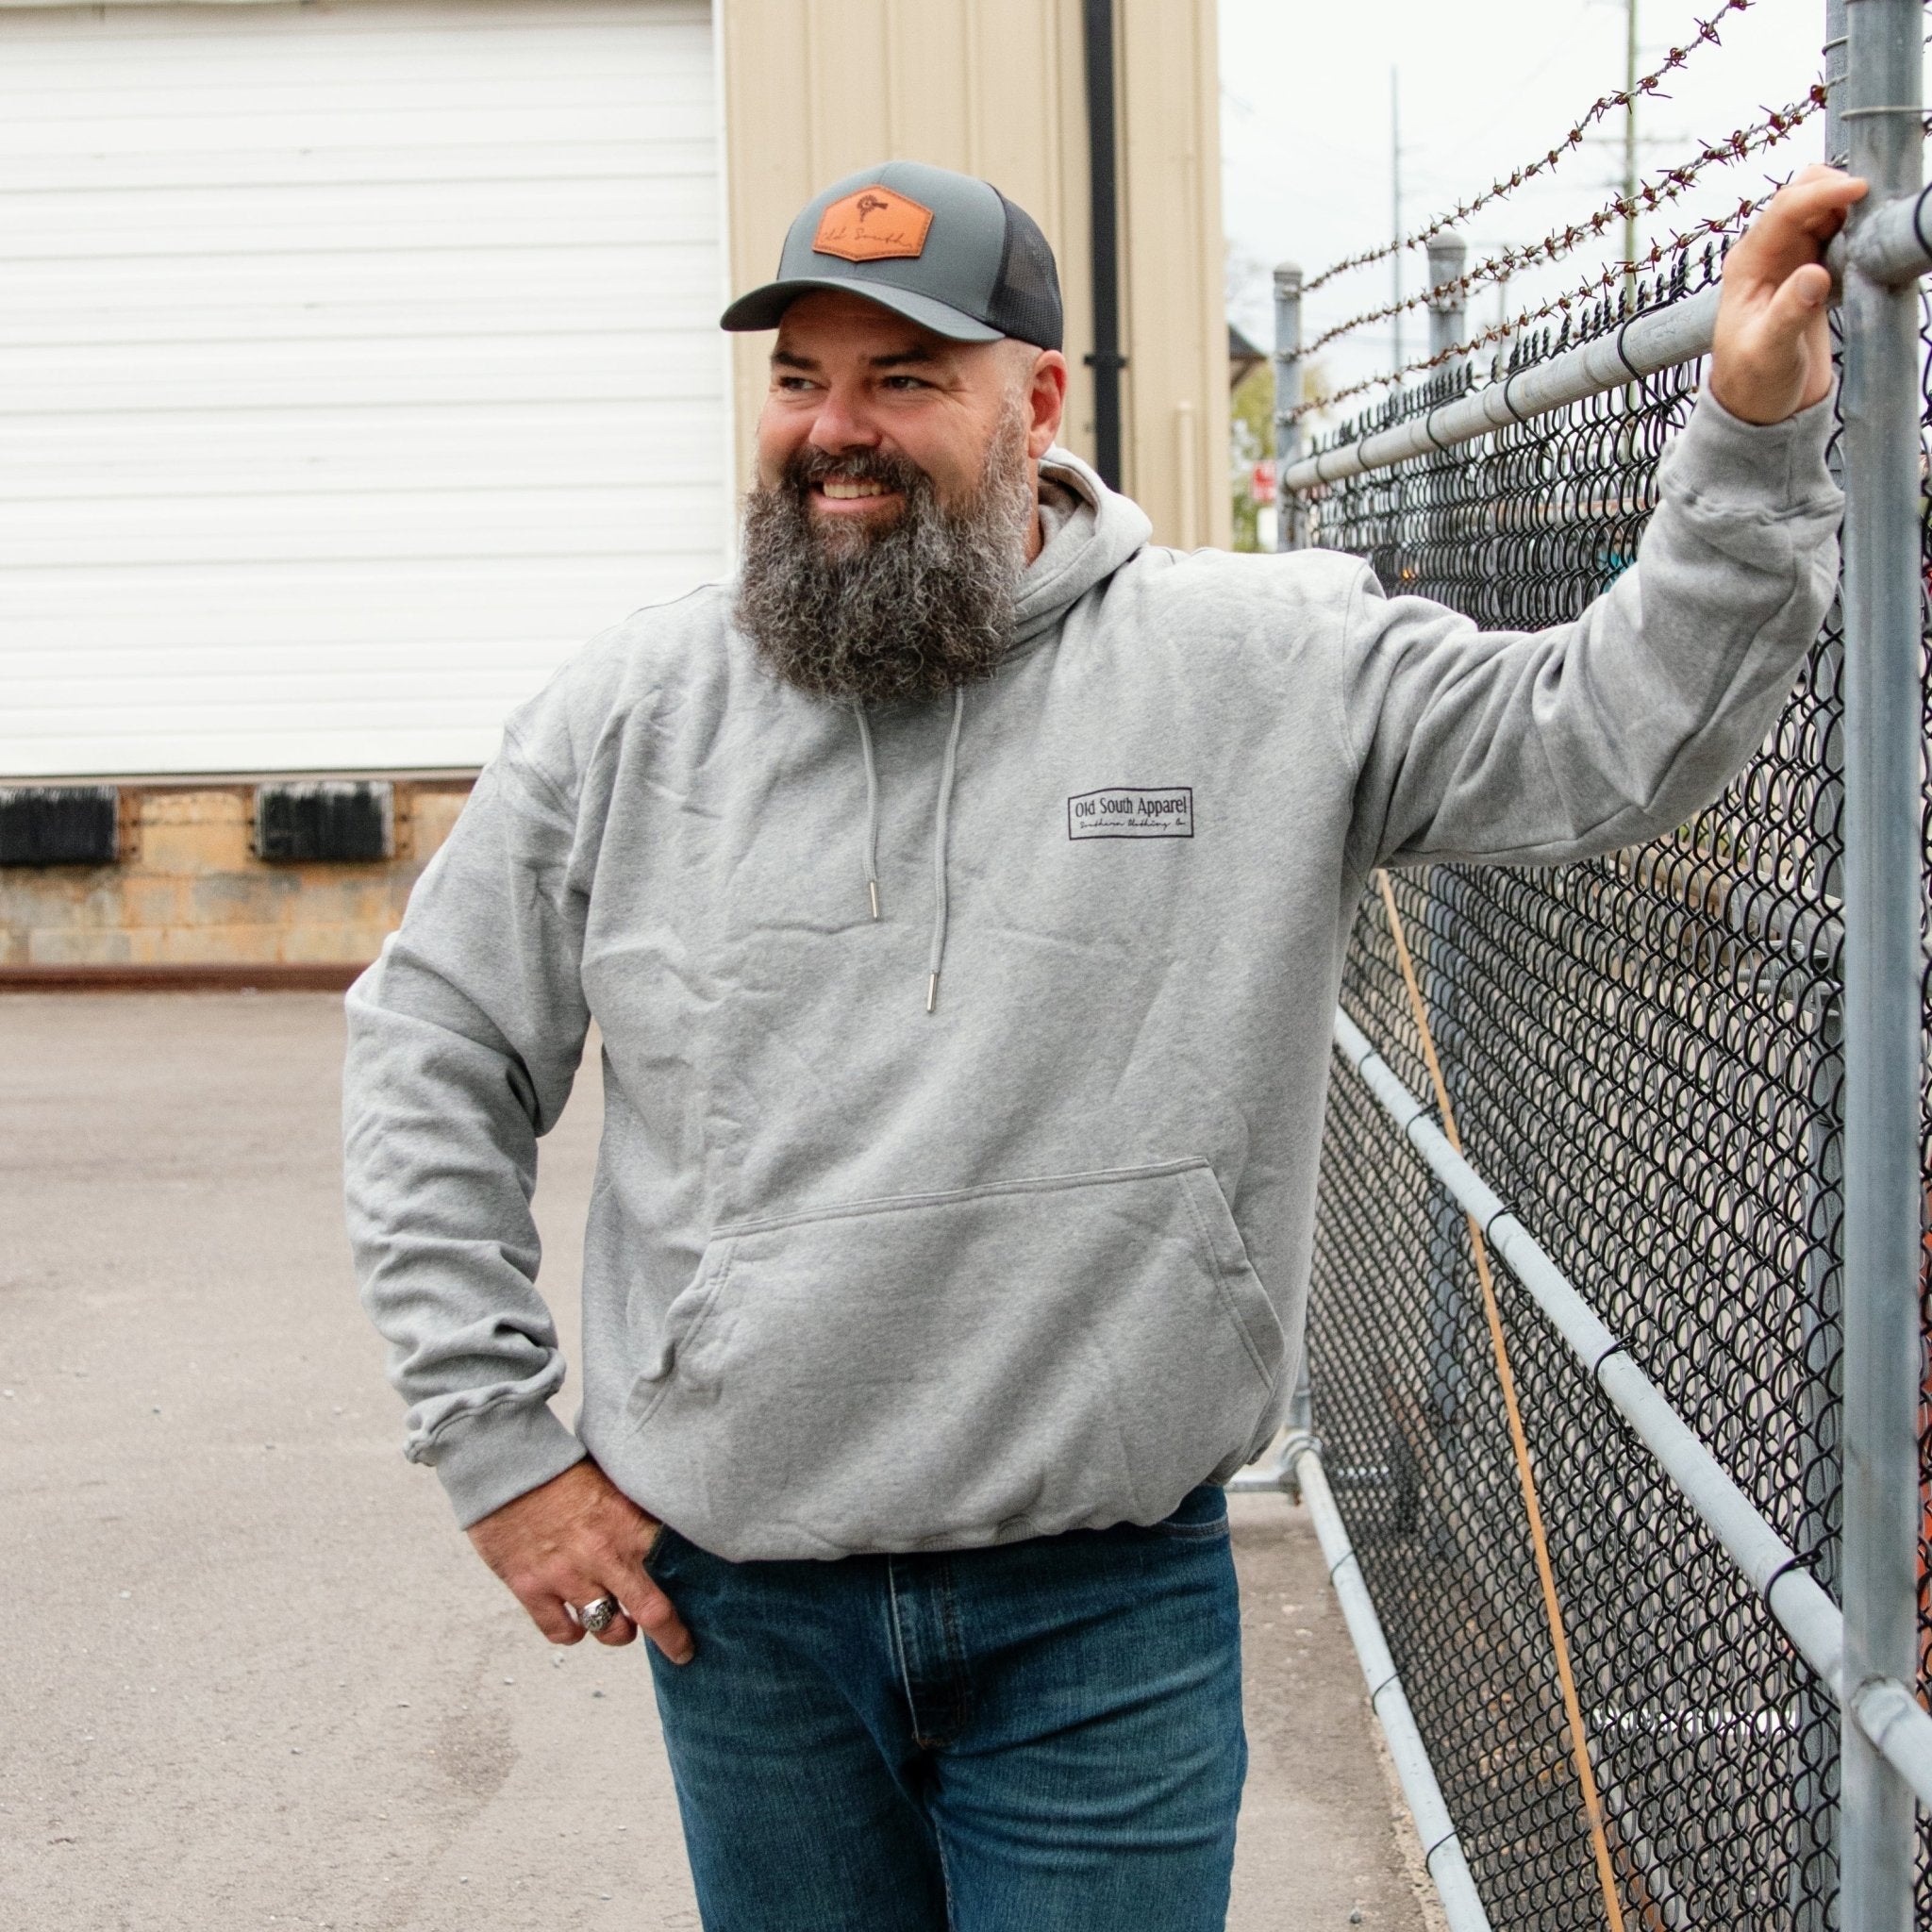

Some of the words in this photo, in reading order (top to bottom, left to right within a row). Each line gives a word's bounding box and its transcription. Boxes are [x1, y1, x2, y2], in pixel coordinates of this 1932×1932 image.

[1075, 800, 1095, 817] Old
[1099, 797, 1133, 814] South
[1138, 796, 1187, 817] Apparel
